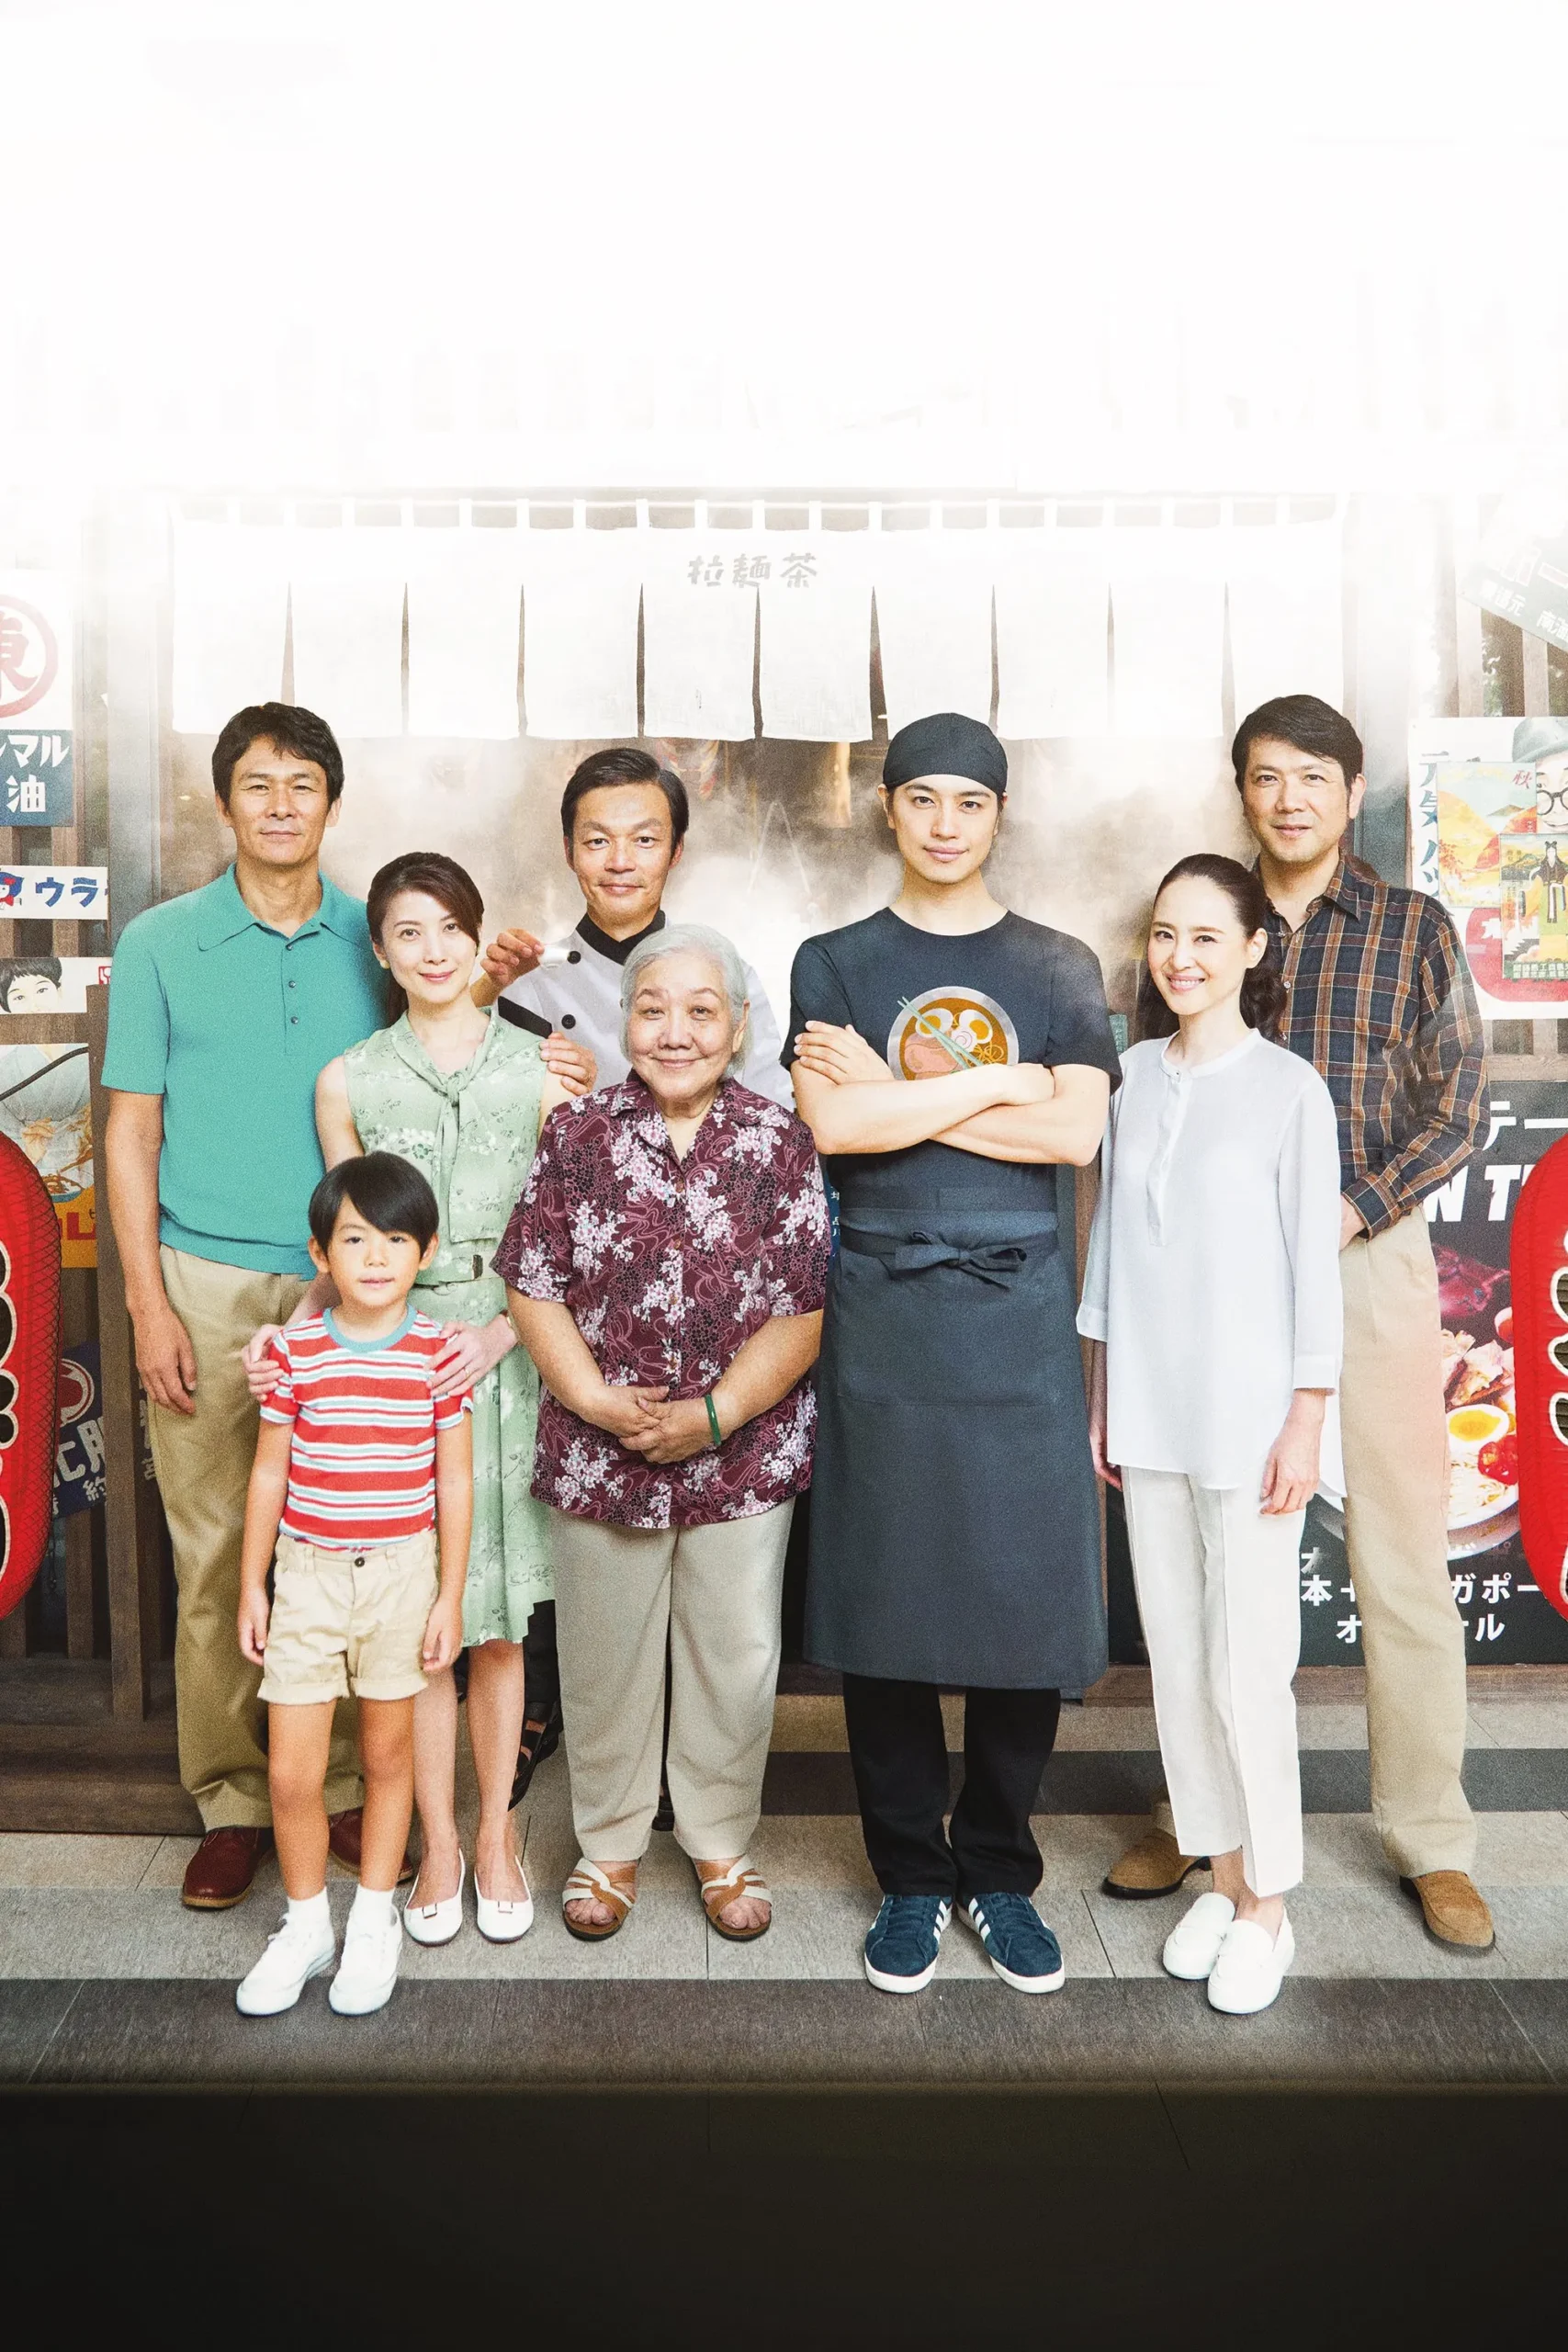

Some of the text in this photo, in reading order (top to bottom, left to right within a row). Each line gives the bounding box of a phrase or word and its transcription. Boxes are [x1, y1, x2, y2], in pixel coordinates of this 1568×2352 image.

[0, 734, 70, 768] マル
[6, 774, 46, 813] 油
[35, 876, 108, 908] ウラ
